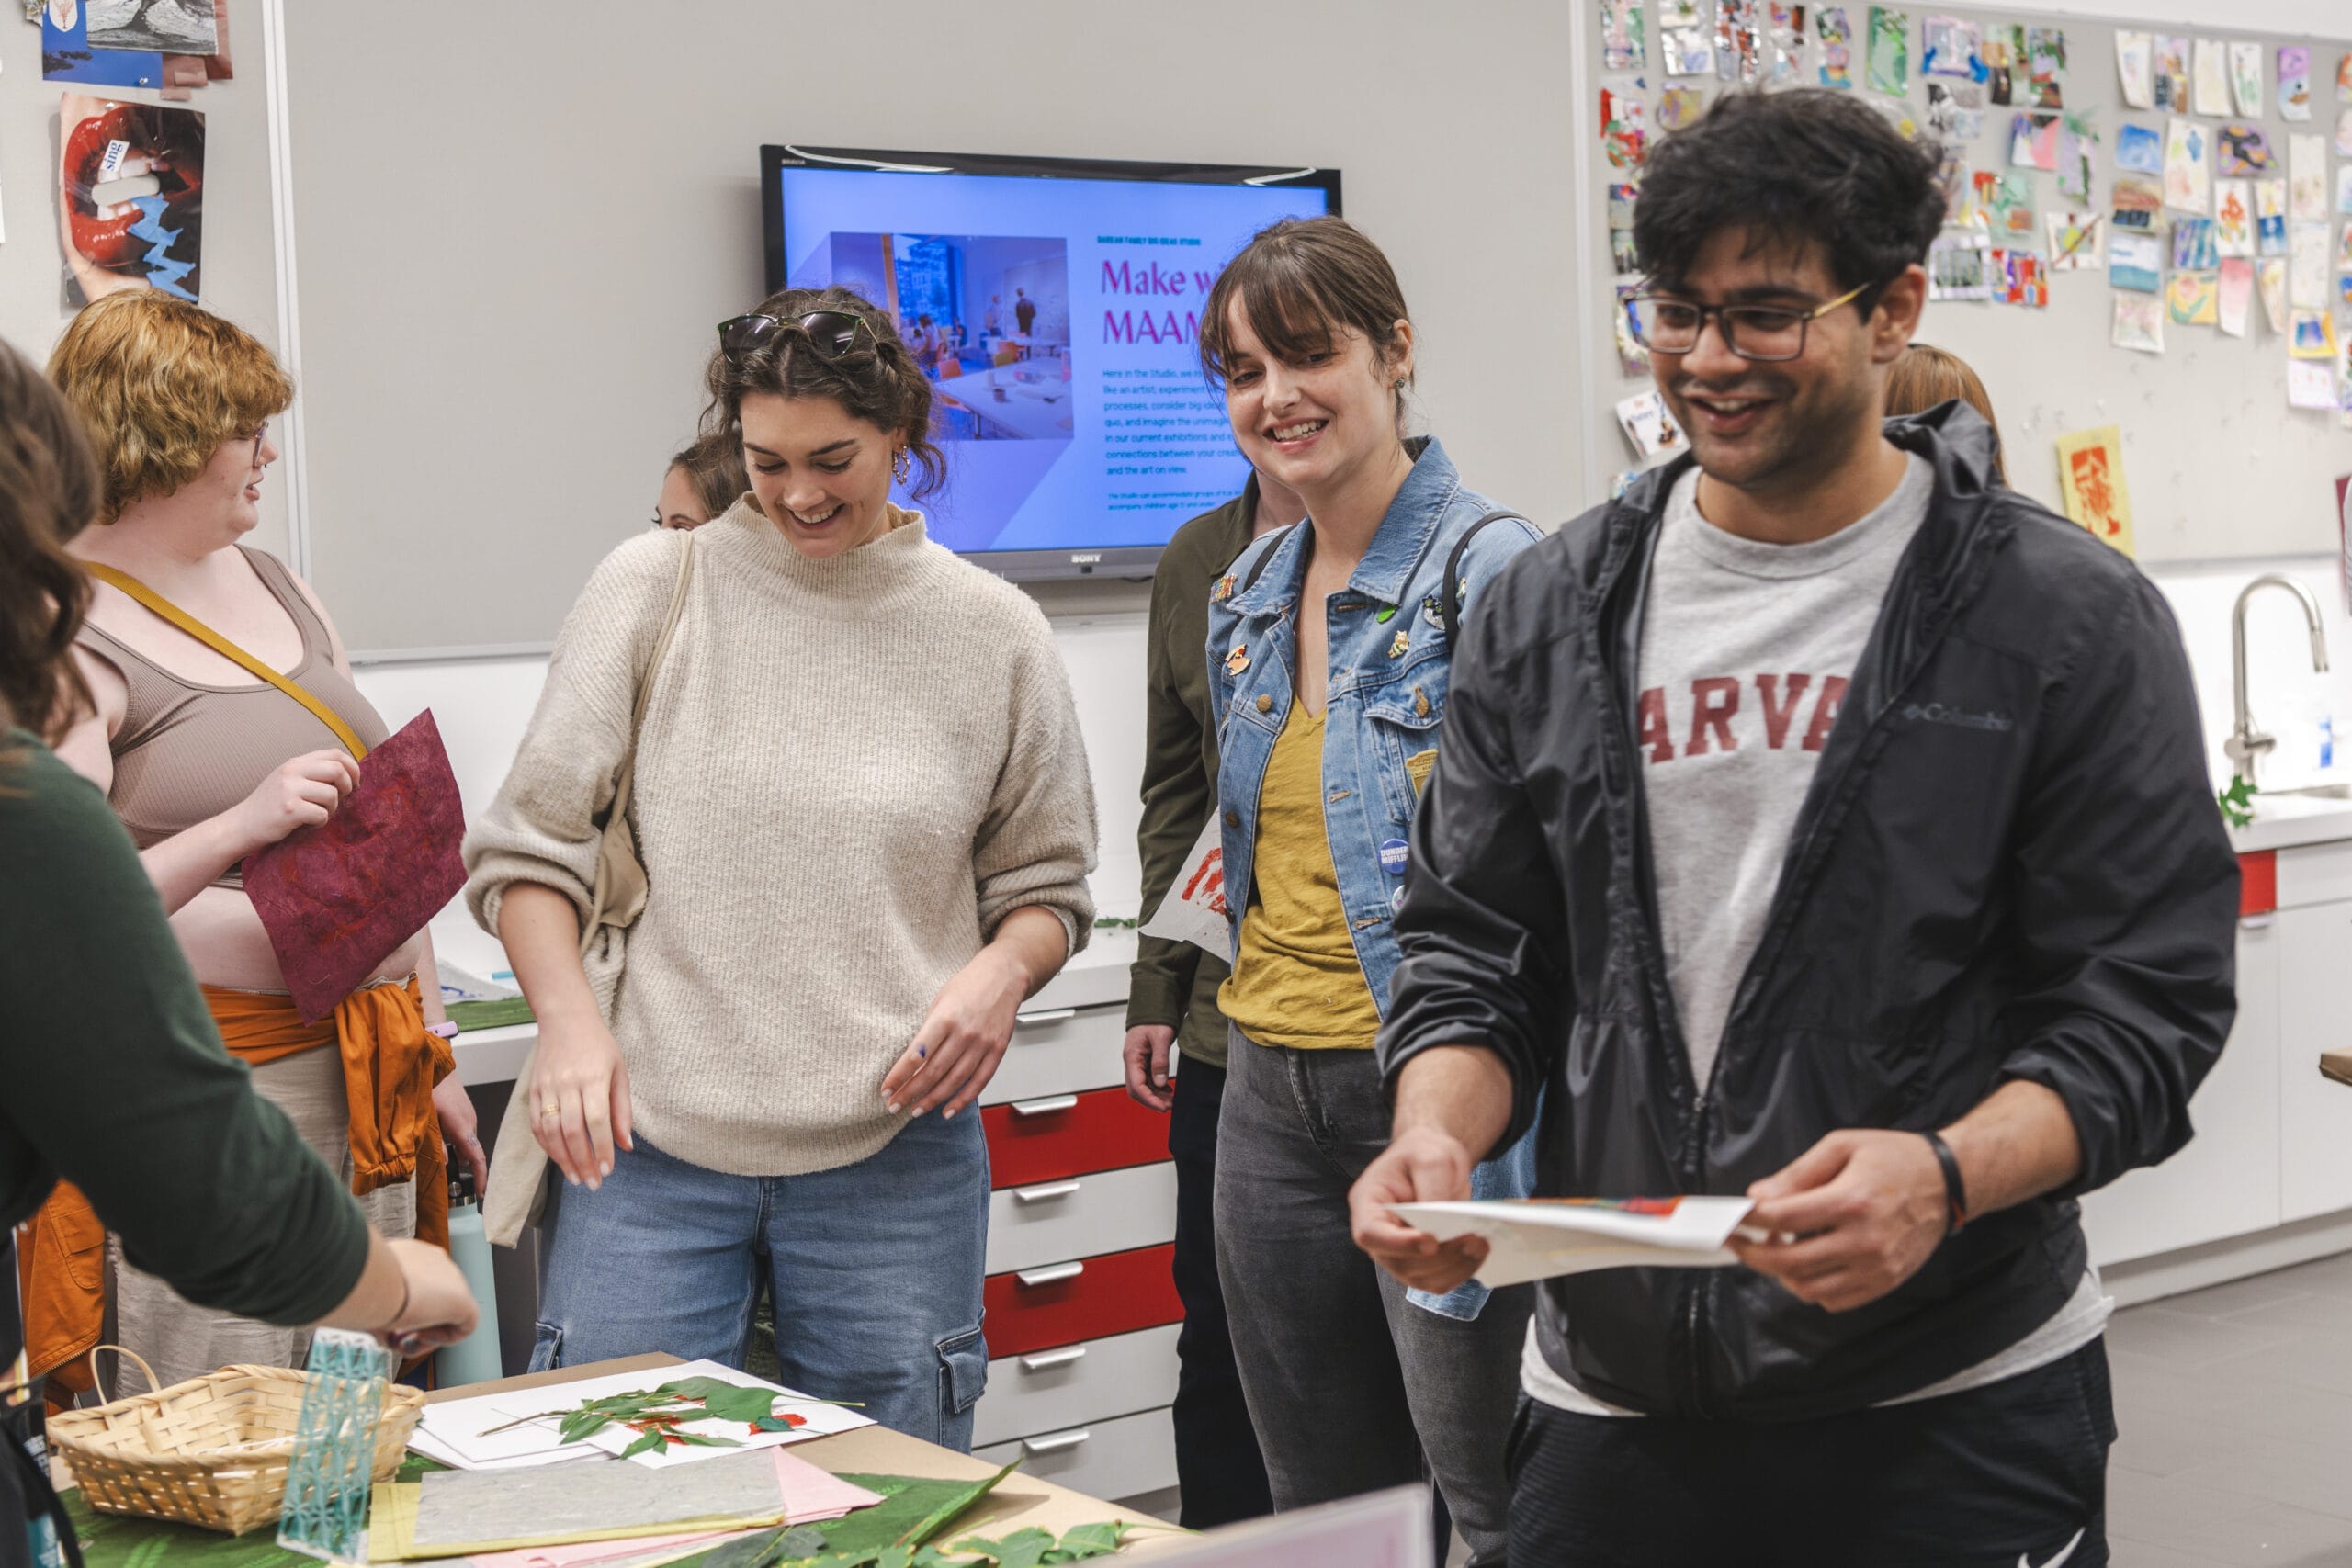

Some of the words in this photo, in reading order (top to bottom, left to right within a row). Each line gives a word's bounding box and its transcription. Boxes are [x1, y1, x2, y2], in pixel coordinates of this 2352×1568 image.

[104, 142, 123, 171] sing
[1102, 260, 1186, 296] Make
[1125, 418, 1141, 427] and
[1177, 417, 1191, 426] the
[1106, 466, 1123, 475] and
[1125, 466, 1138, 475] the
[1140, 466, 1153, 474] art
[1071, 554, 1102, 564] SONY
